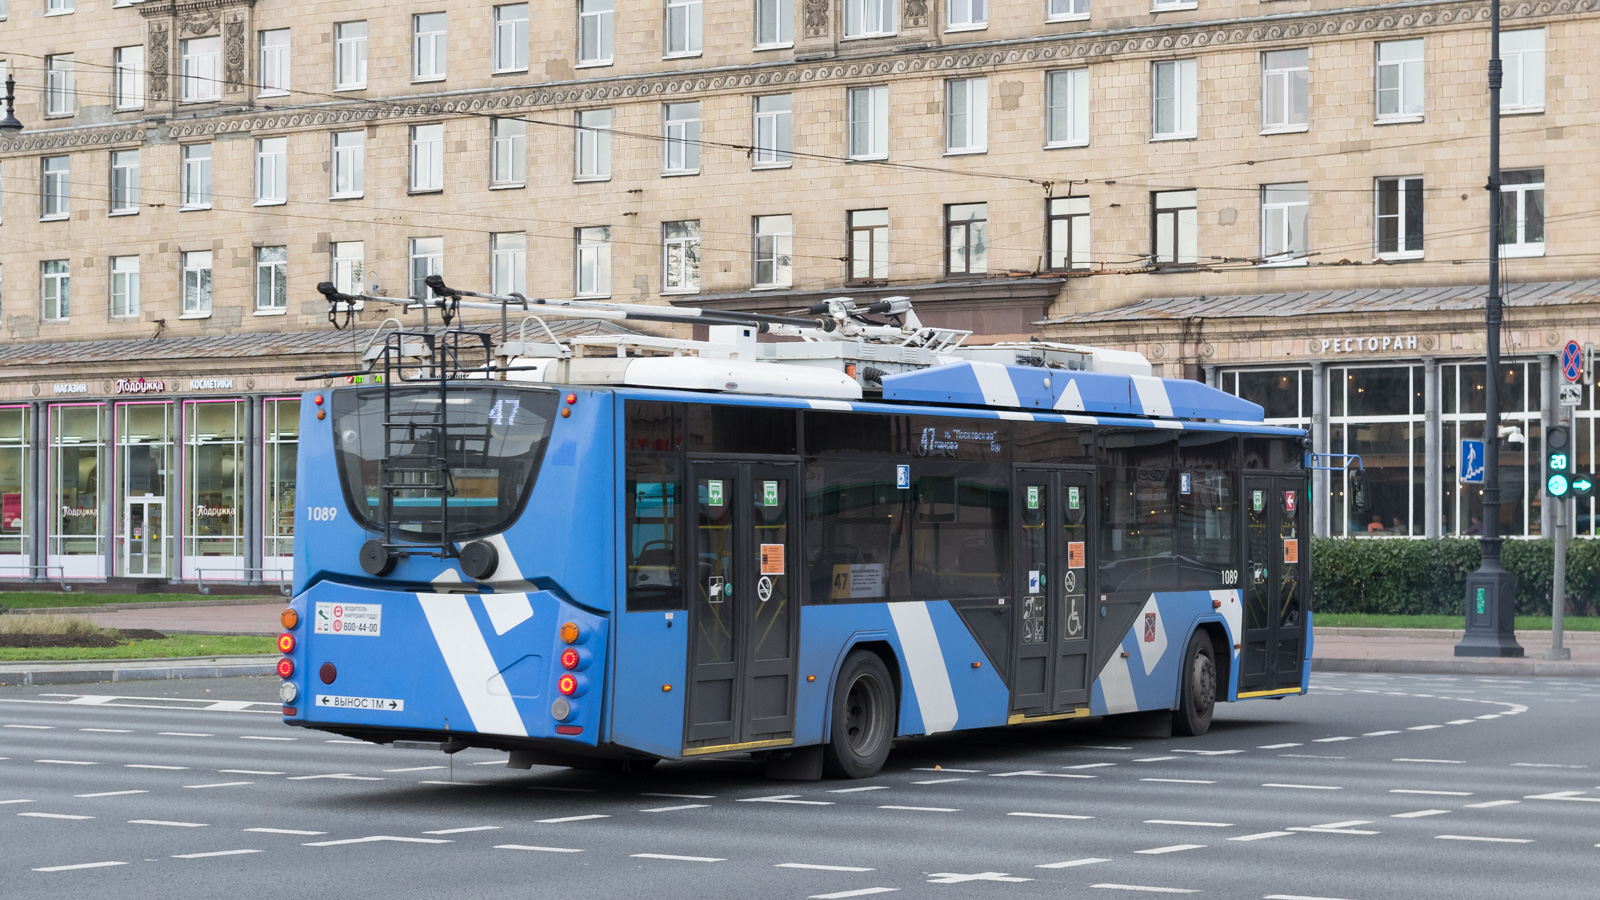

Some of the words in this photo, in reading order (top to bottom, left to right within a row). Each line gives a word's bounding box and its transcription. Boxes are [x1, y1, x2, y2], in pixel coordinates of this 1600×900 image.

[1321, 335, 1418, 352] РЕСТОРАН
[53, 384, 87, 394] МАГАЗИН
[116, 378, 164, 394] Подружка
[189, 379, 234, 390] КОСМЕТИКИ
[488, 399, 520, 426] 47
[921, 427, 936, 450] 47
[1550, 454, 1567, 470] 20
[307, 507, 337, 520] 1089
[834, 573, 849, 590] 47
[1221, 569, 1239, 585] 1089
[343, 622, 378, 632] 600-44-00
[334, 697, 369, 708] ВЫНОС
[371, 700, 384, 709] 1М
